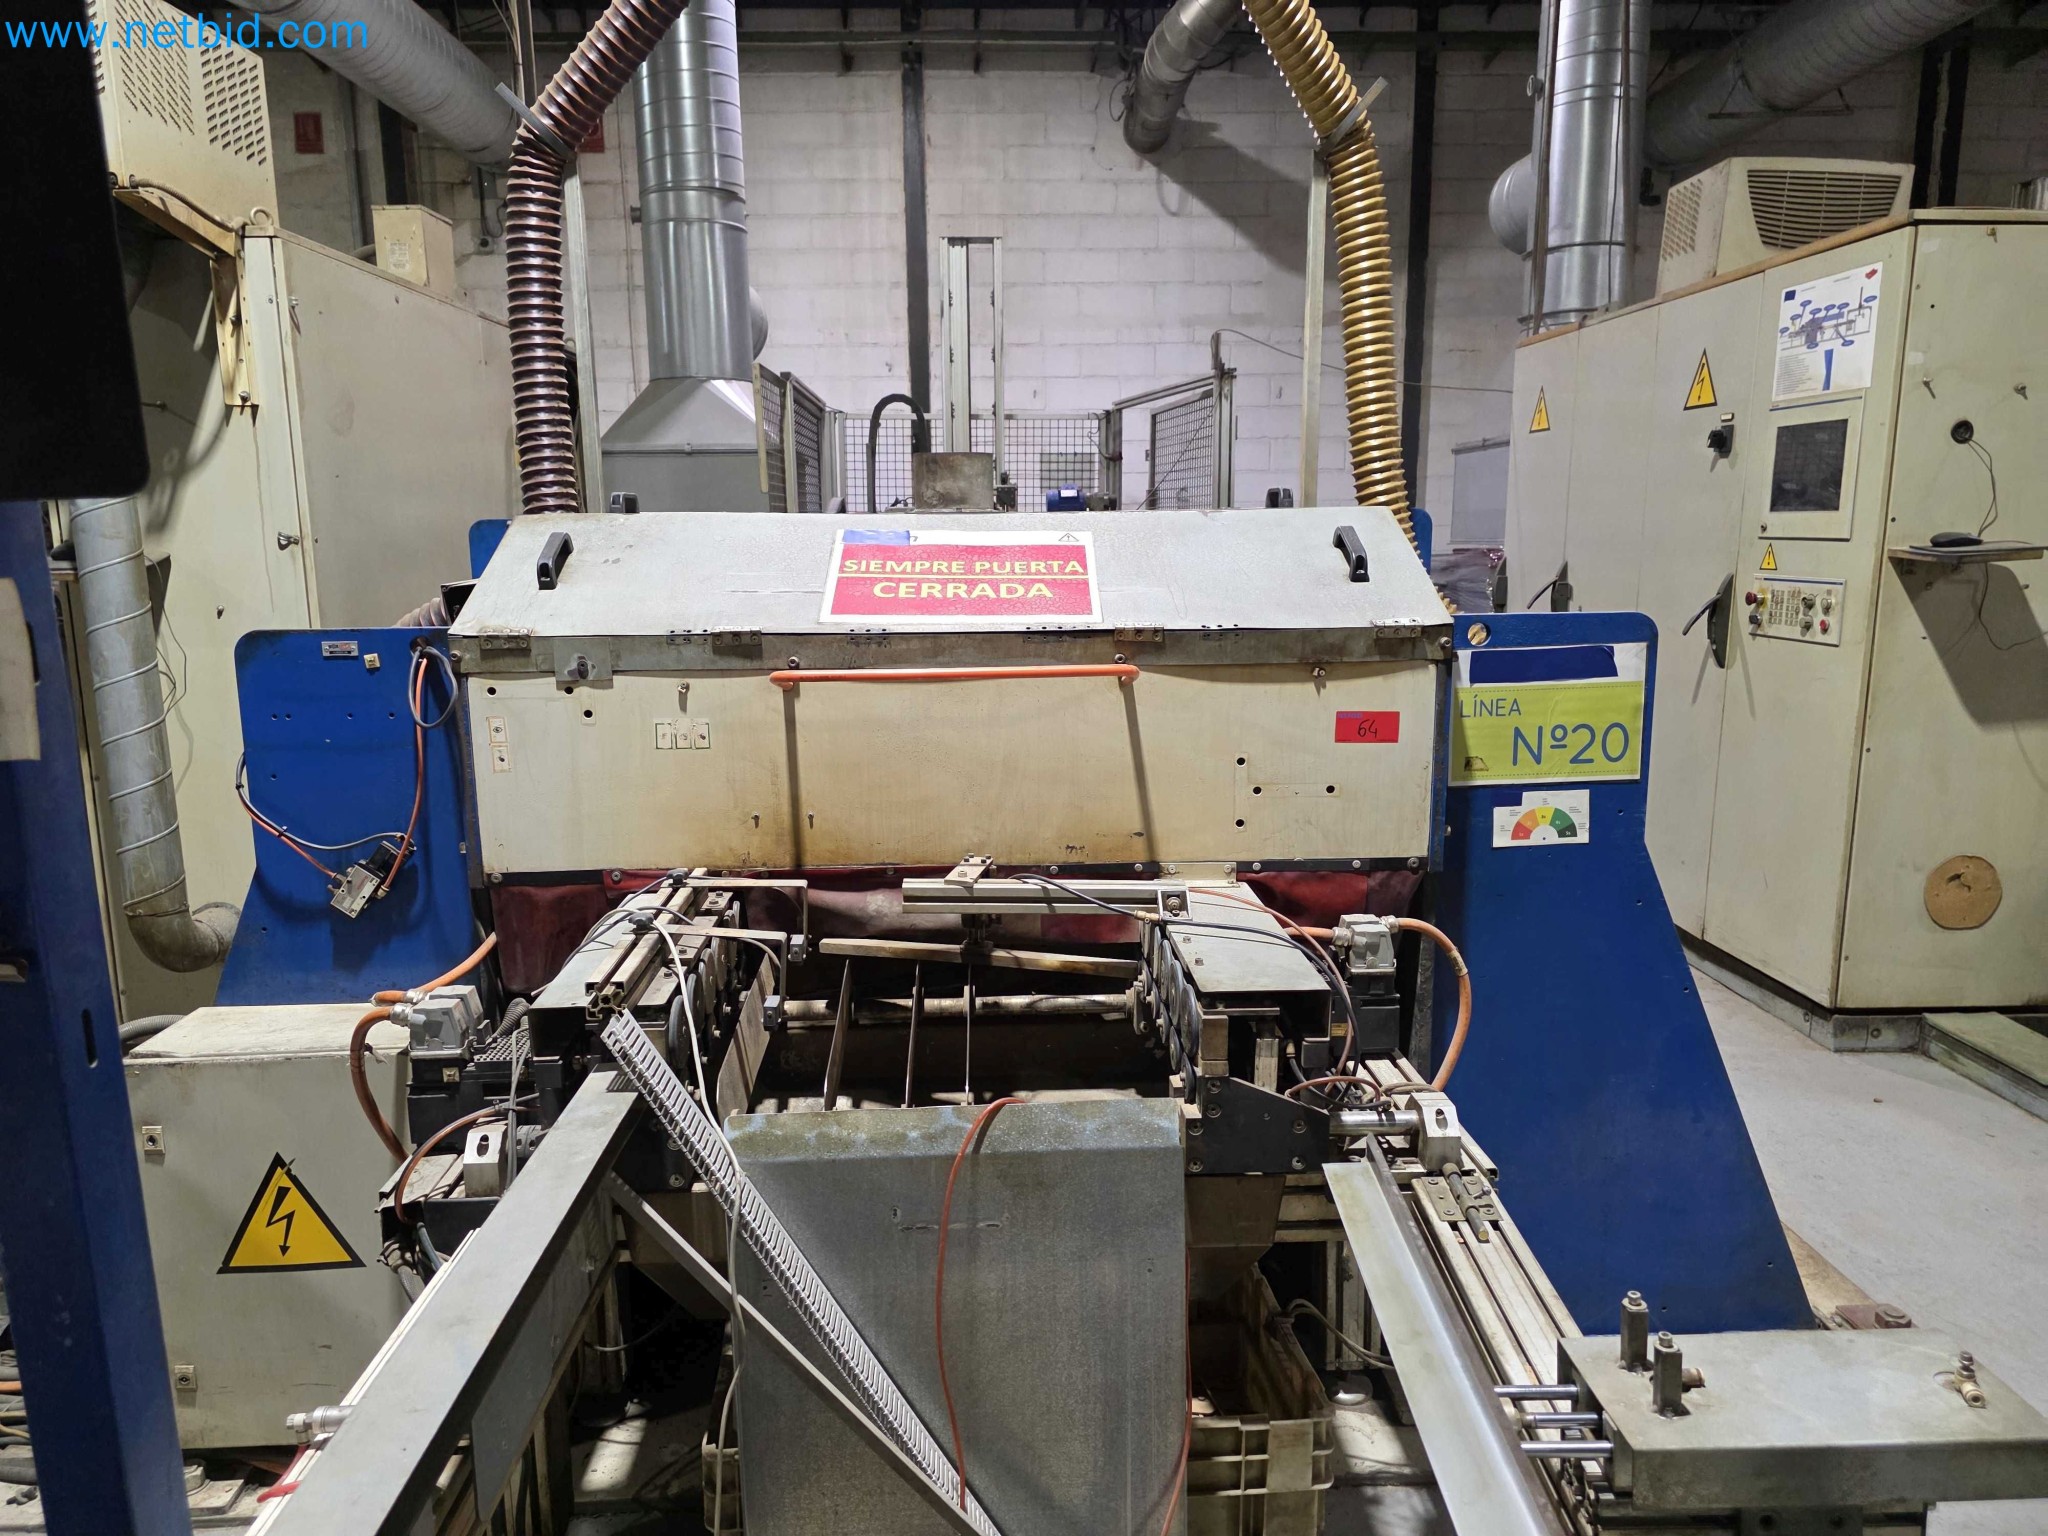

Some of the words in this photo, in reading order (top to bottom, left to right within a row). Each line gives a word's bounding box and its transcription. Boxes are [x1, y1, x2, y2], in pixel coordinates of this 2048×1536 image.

[843, 559, 965, 574] SIEMPRE
[974, 559, 1085, 574] PUERTA
[872, 581, 1054, 599] CERRADA
[1460, 694, 1522, 718] LÍNEA
[1357, 718, 1379, 739] 64
[1511, 721, 1630, 767] Nº20
